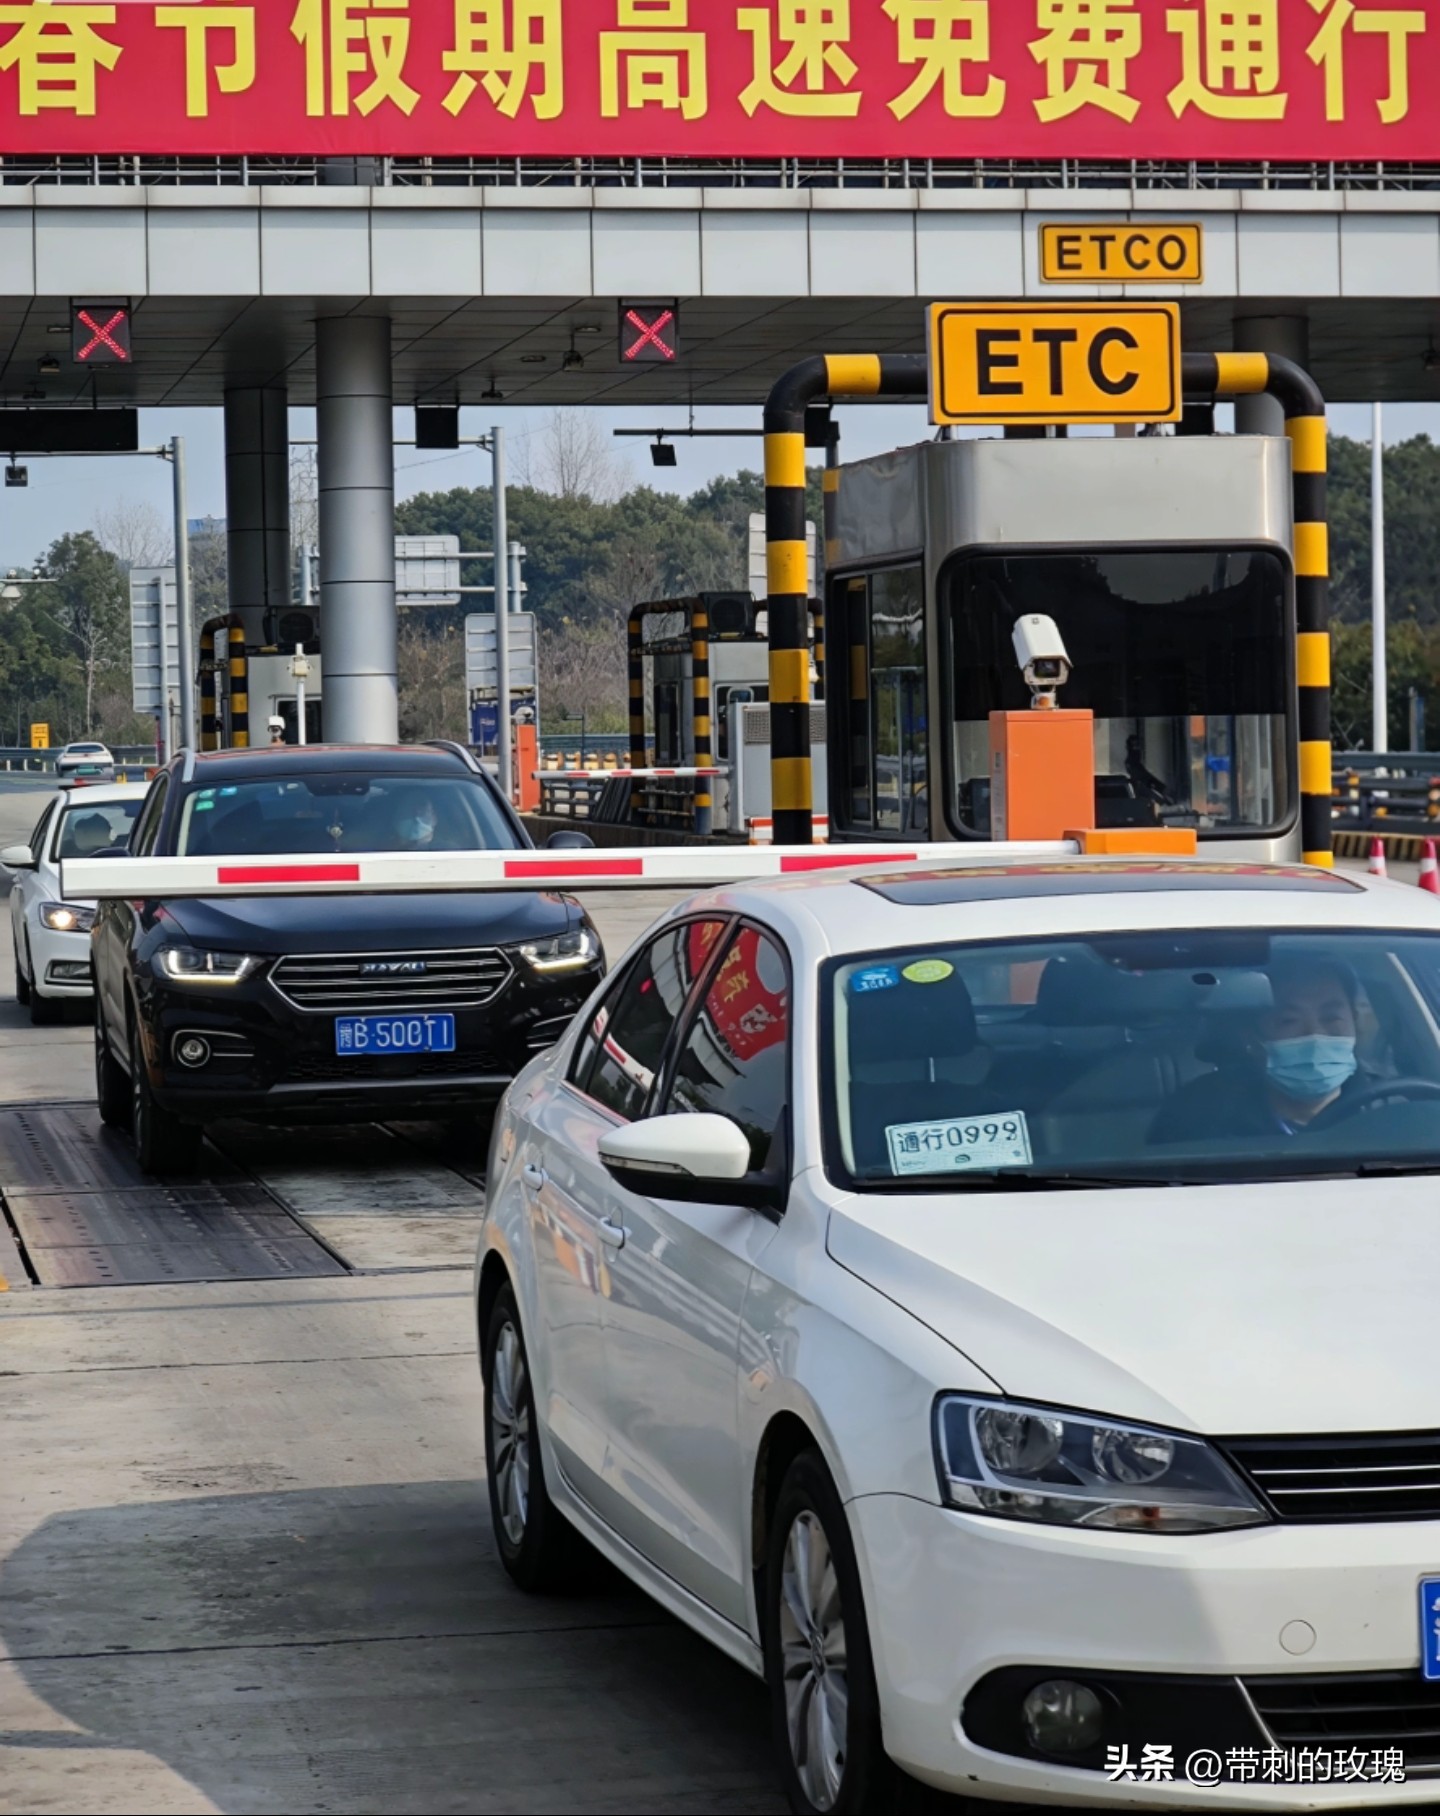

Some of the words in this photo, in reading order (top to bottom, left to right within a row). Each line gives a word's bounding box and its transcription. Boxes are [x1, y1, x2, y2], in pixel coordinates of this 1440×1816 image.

[0, 0, 1426, 124] 春节假期高速免费通行
[1056, 234, 1187, 271] ETCO
[975, 326, 1139, 396] ETC
